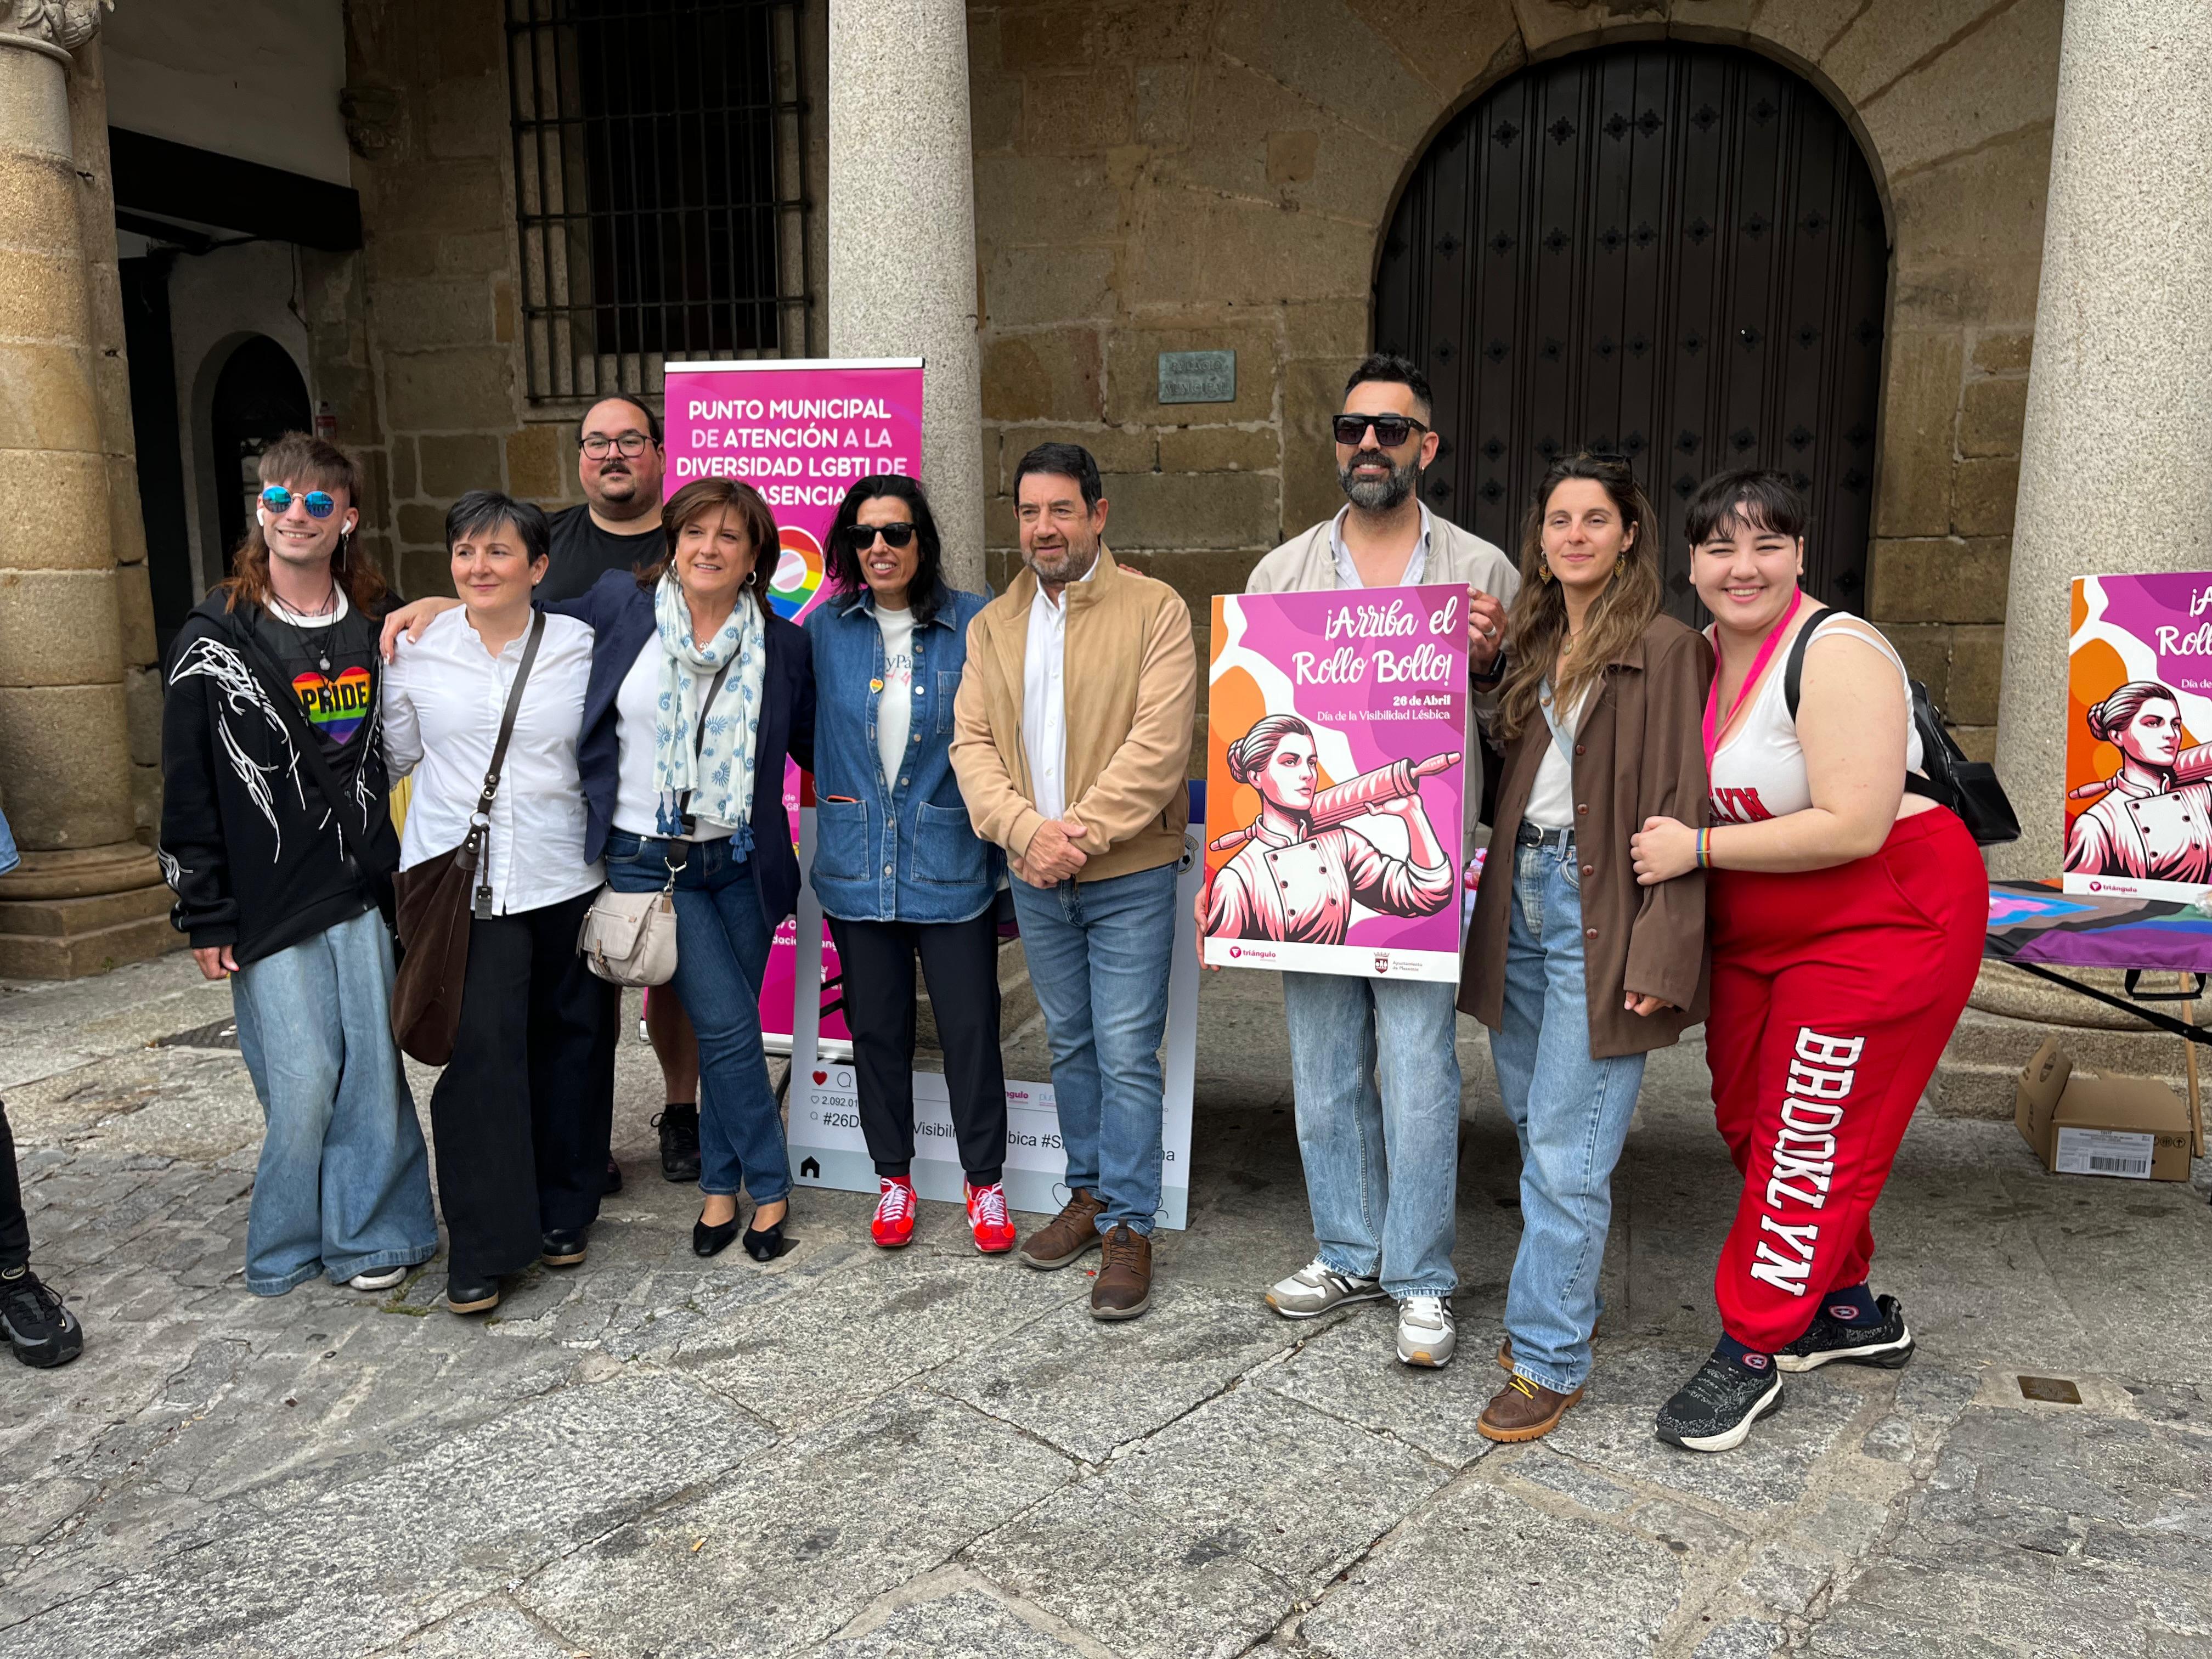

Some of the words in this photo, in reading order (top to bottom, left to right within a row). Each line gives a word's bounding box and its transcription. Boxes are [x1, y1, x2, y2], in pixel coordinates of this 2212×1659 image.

[689, 399, 764, 420] PUNTO
[769, 398, 892, 420] MUNICIPAL
[692, 428, 719, 448] DE
[723, 422, 838, 448] ATENCIÓN
[843, 428, 859, 448] A
[865, 428, 893, 448] LA
[676, 456, 803, 477] DIVERSIDAD
[809, 456, 870, 477] LGBTI
[877, 457, 908, 476] DE
[1429, 596, 1458, 635] el
[1291, 646, 1368, 685] Rollo
[1372, 643, 1453, 687] Bollo!
[2181, 679, 2198, 689] Día
[301, 682, 368, 715] PRIDE
[1392, 696, 1407, 707] 26
[1409, 695, 1421, 706] de
[1423, 694, 1452, 706] Abril
[1317, 710, 1333, 721] Día
[1335, 710, 1347, 721] de
[1348, 710, 1357, 721] la
[1358, 709, 1410, 720] Visibilidad
[1412, 709, 1451, 720] Lésbica
[1243, 950, 1276, 958] triángulo
[1750, 1026, 1866, 1297] BROOKLYN
